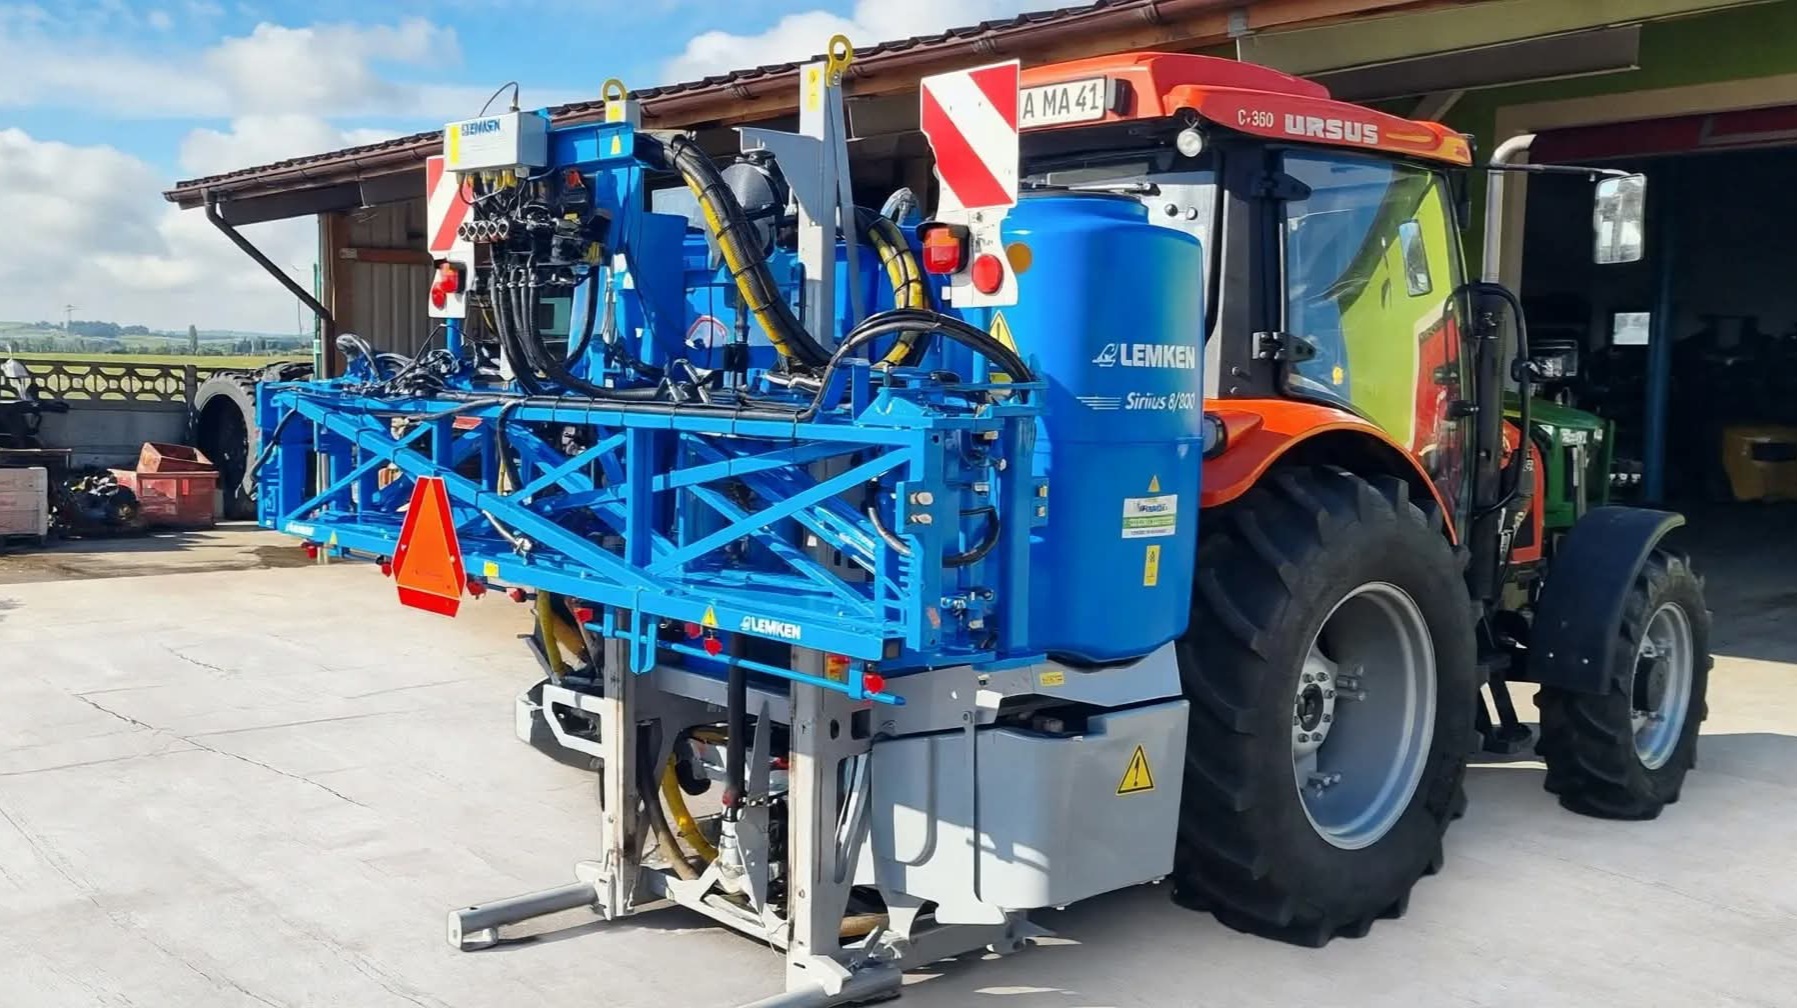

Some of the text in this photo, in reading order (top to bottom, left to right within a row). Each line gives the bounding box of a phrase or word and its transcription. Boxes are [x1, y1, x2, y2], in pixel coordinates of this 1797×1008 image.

[1022, 82, 1099, 120] A MA 41
[1284, 113, 1379, 145] URSUS
[1120, 343, 1195, 369] LEMKEN
[751, 616, 801, 640] LEMKEN
